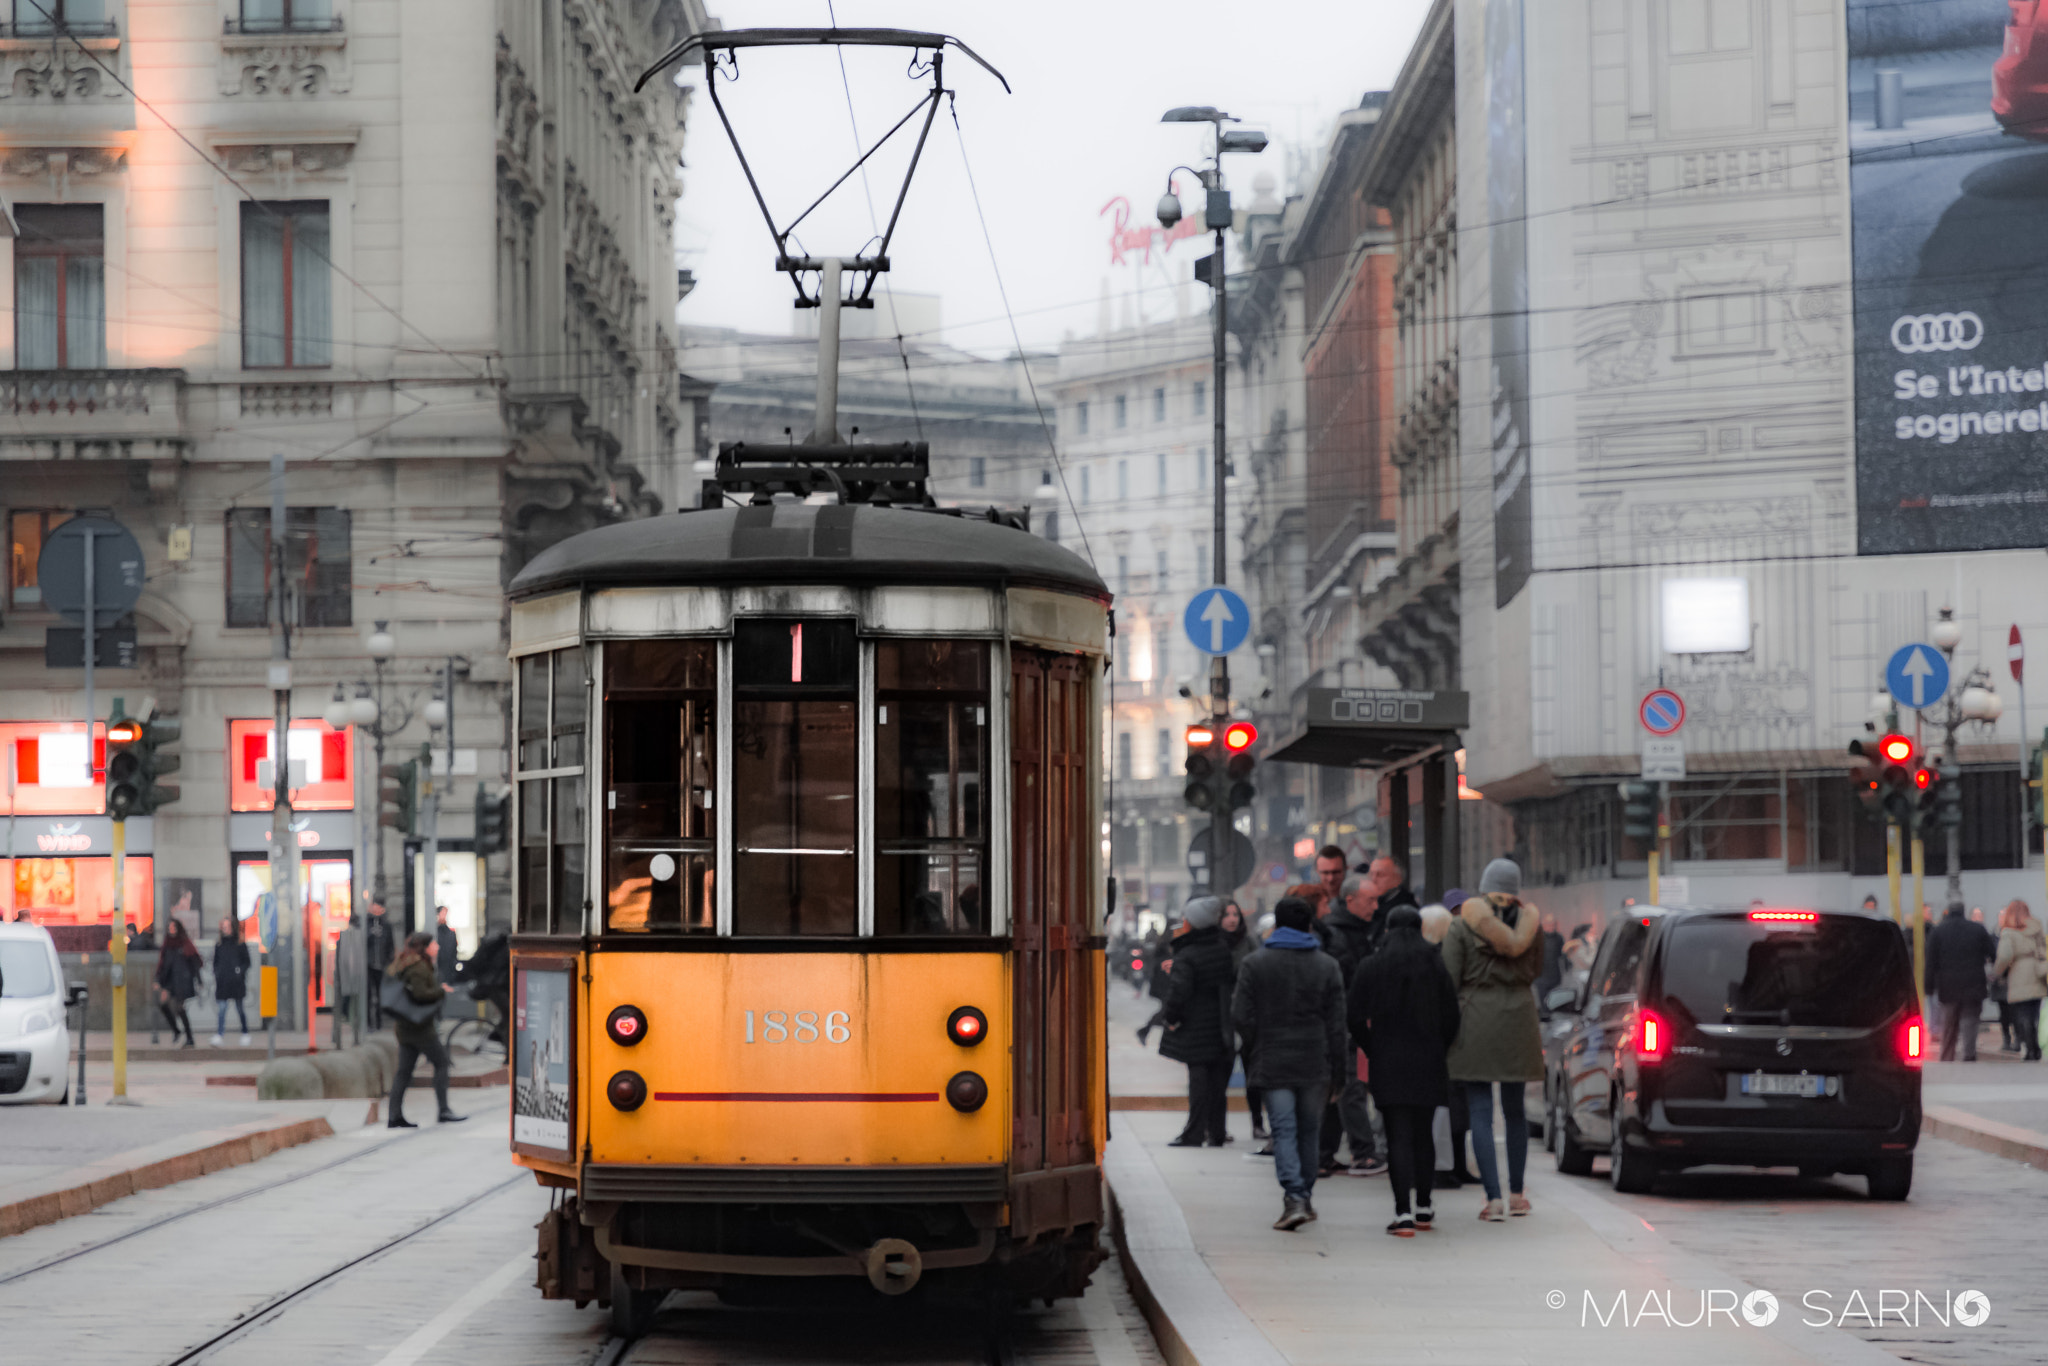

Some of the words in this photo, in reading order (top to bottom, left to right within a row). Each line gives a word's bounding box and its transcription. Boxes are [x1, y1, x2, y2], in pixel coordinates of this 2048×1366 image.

[1894, 368, 1940, 399] Se
[790, 623, 803, 683] 1
[745, 1010, 851, 1043] 1886
